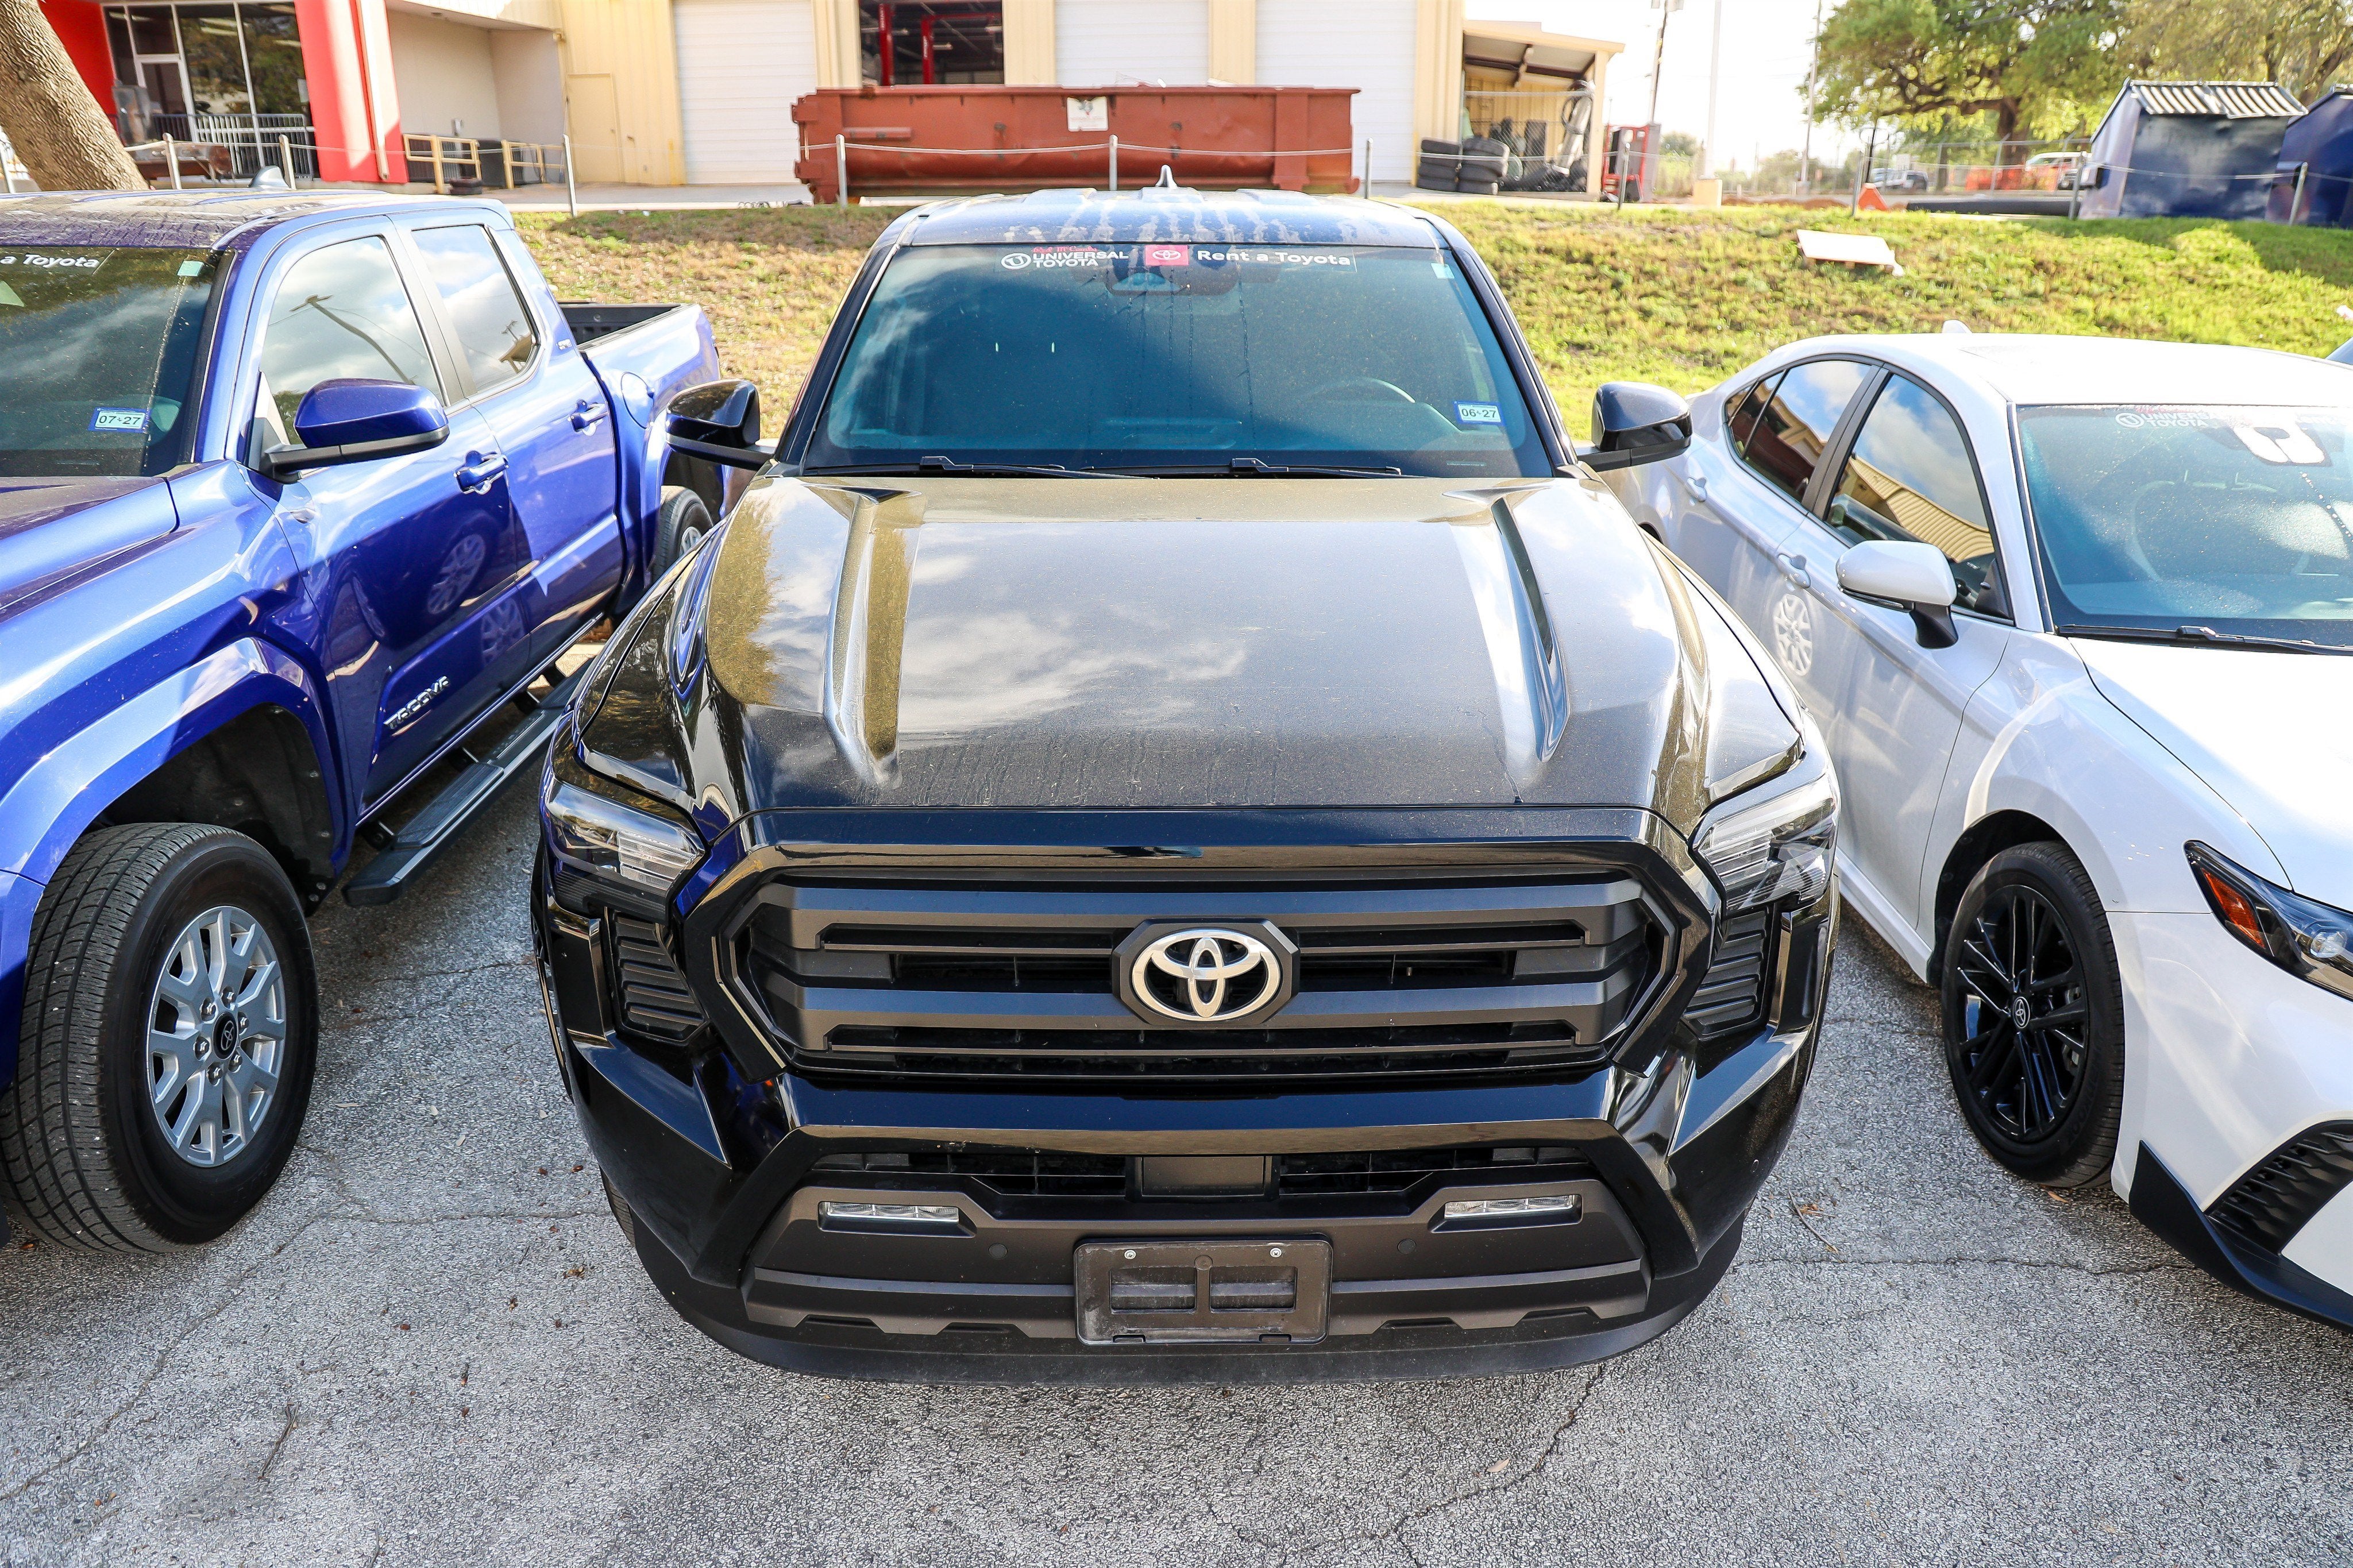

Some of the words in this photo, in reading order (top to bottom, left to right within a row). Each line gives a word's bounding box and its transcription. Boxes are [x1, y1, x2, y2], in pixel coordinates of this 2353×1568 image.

[0, 256, 17, 265] a
[23, 254, 100, 268] Toyota
[1033, 251, 1129, 260] UNIVERSAL
[1197, 250, 1249, 261] Rent
[1256, 252, 1268, 262] a
[1275, 252, 1351, 266] Toyota
[1033, 258, 1099, 268] TOYOTA
[2146, 419, 2209, 427] TOYOTA
[383, 675, 450, 730] TACOMA
